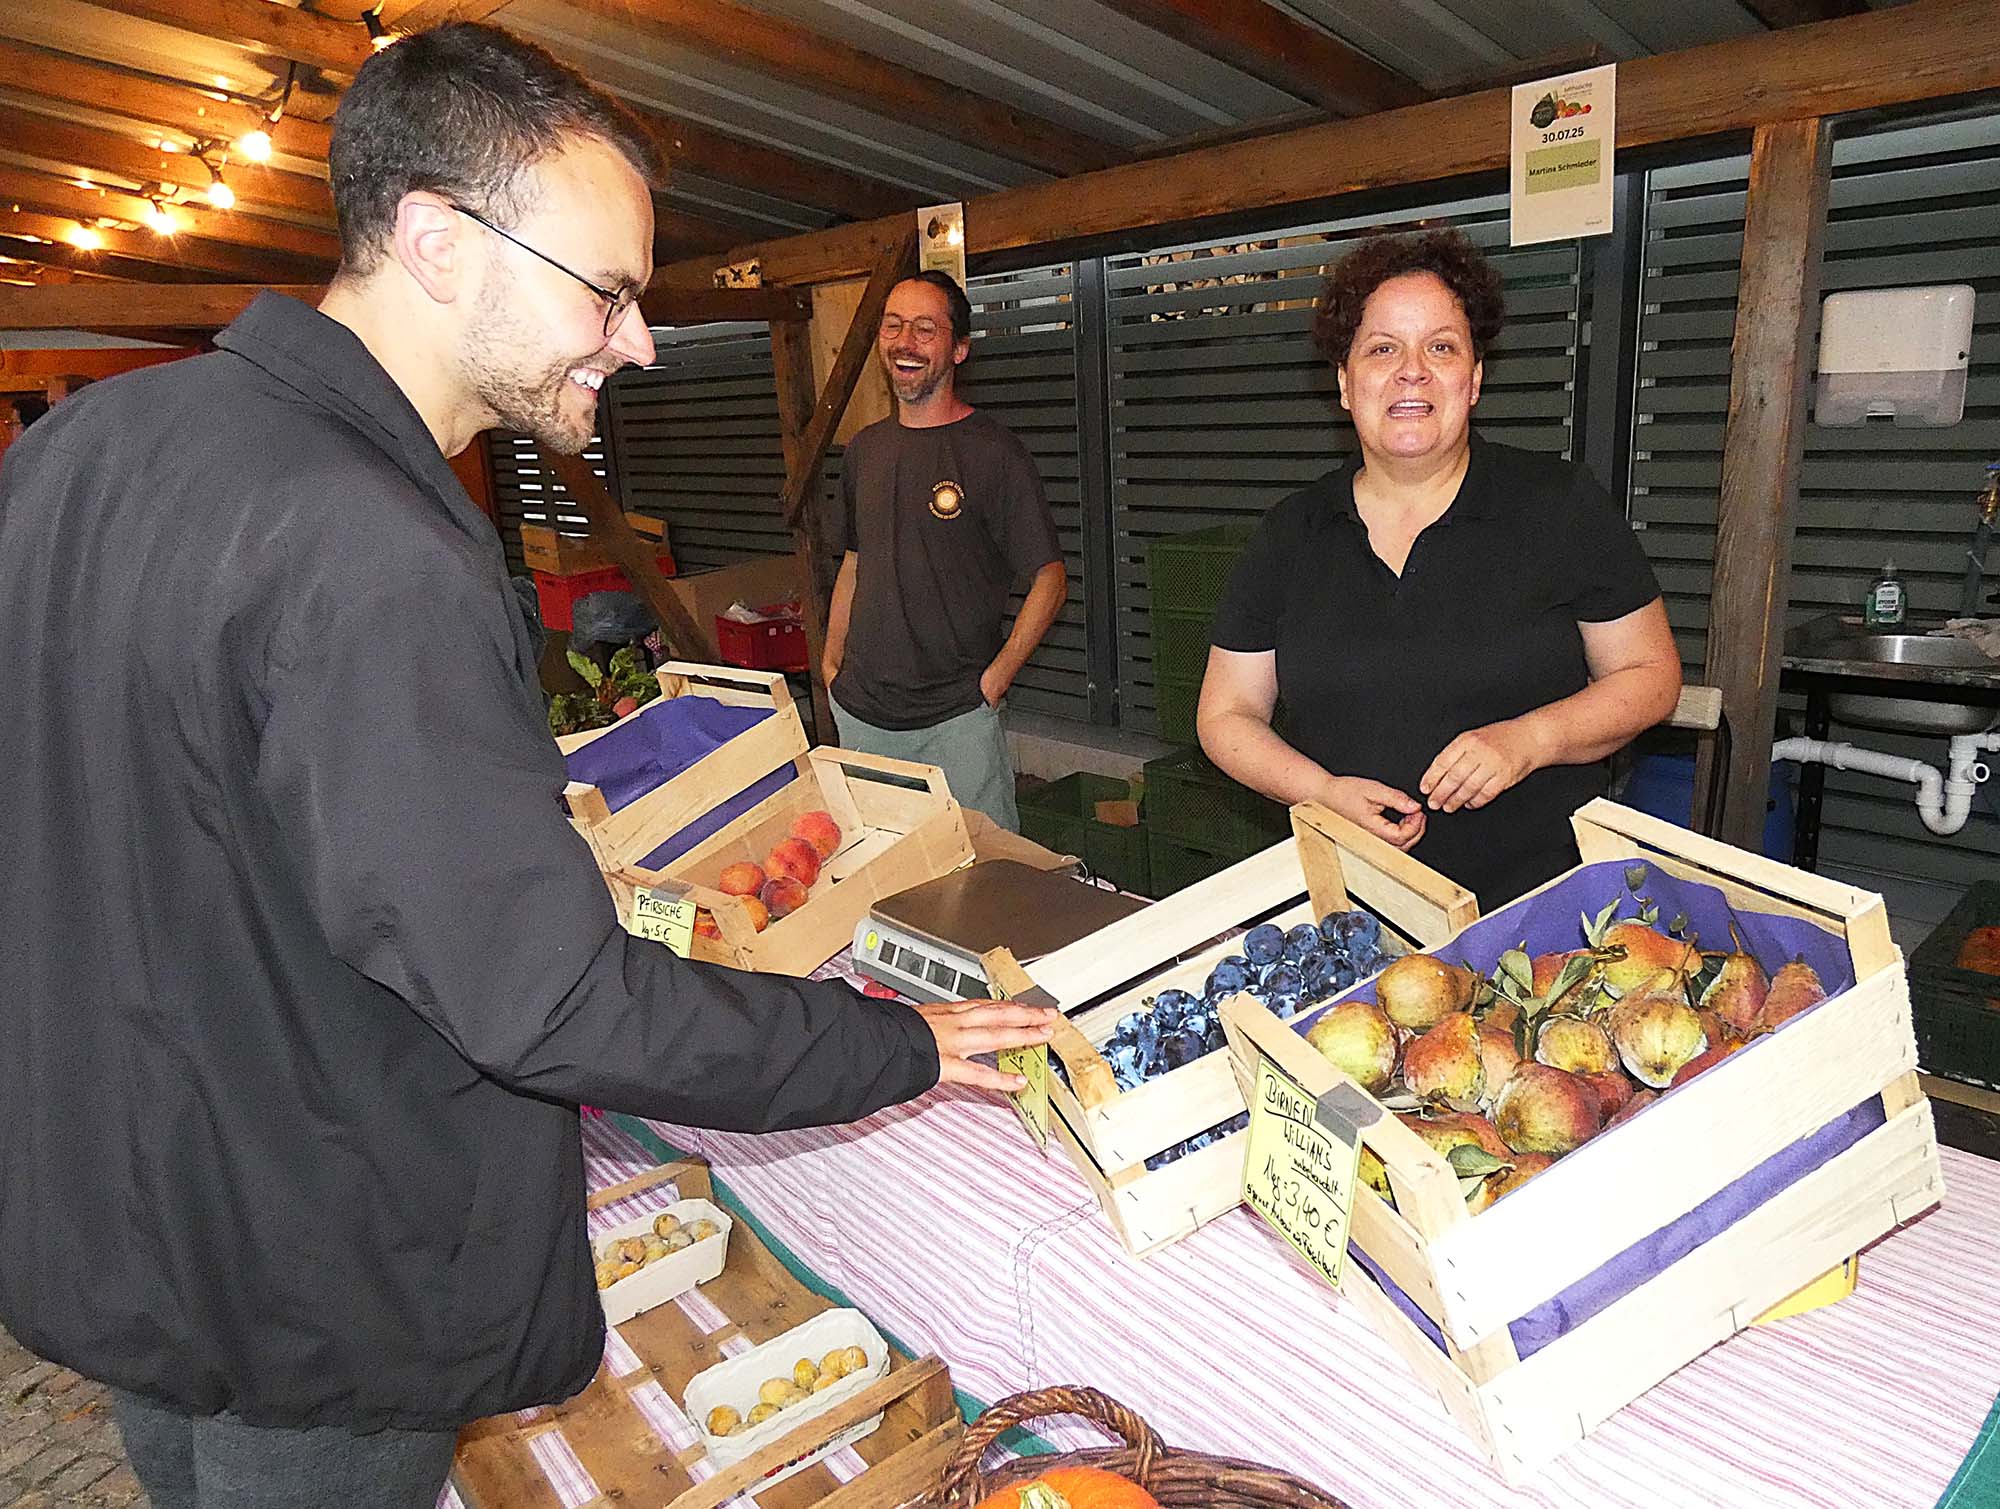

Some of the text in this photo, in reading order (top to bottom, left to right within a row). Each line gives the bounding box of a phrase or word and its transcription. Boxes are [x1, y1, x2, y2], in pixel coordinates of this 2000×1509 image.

[1541, 126, 1585, 144] 30.07.25
[1557, 159, 1597, 172] Schmieder
[637, 894, 683, 919] PFIRSICHE
